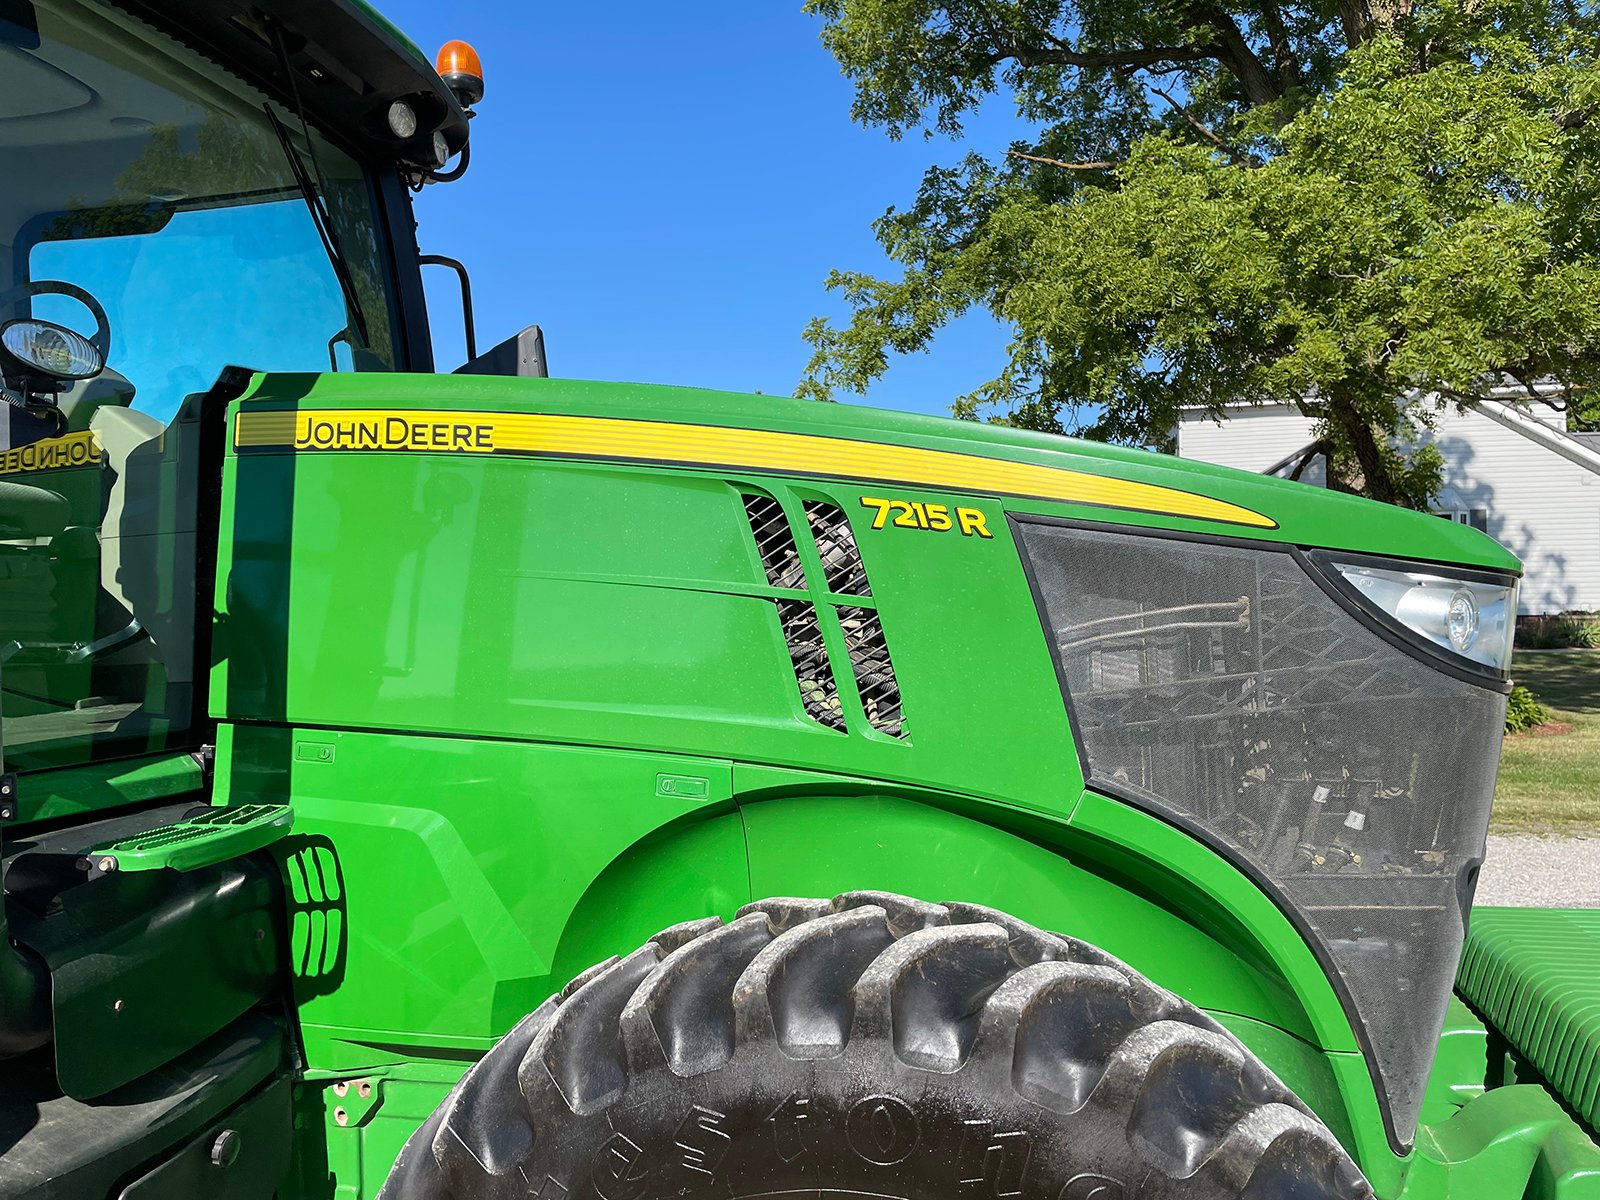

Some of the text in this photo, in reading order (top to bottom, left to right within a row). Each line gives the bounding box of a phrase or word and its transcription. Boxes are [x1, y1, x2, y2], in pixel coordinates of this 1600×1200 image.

[296, 417, 494, 448] JOHN DEERE
[859, 496, 994, 539] 7215 R
